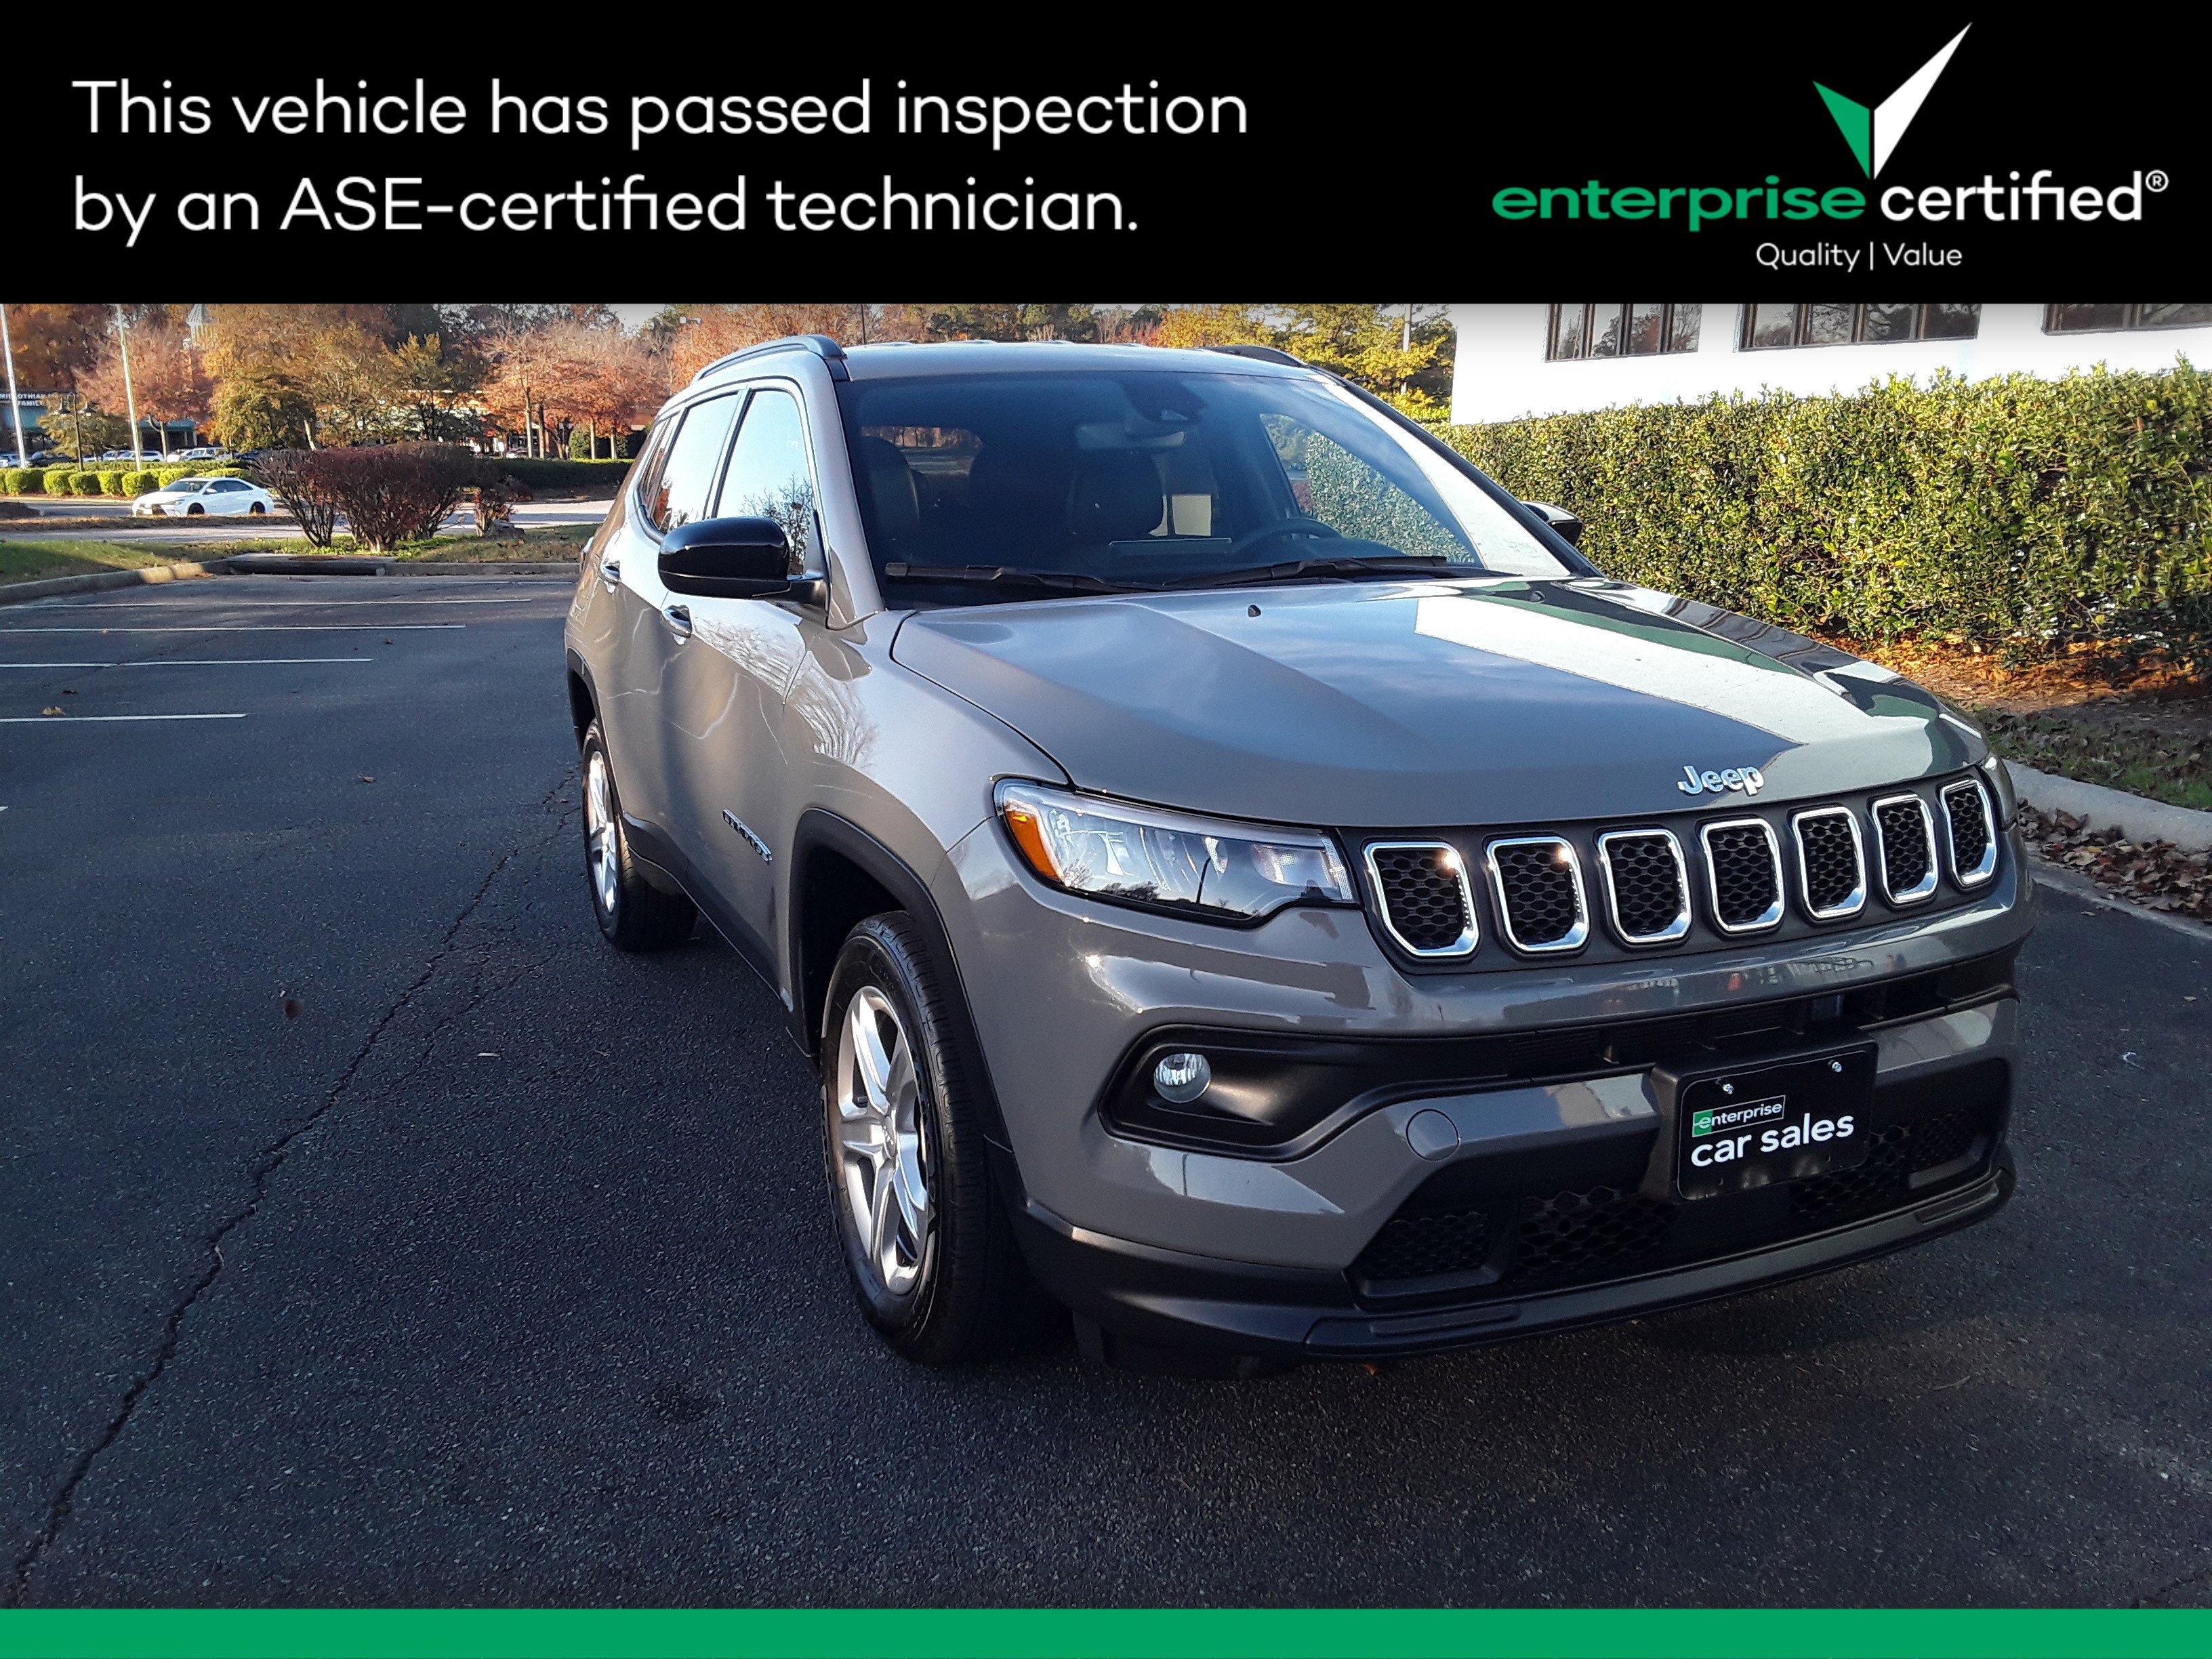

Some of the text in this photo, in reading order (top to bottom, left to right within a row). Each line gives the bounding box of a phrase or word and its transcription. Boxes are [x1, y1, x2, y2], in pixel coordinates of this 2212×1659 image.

[1677, 765, 1765, 796] Jeep
[1695, 1101, 1783, 1130] enterprise
[1691, 1112, 1855, 1168] car sales
